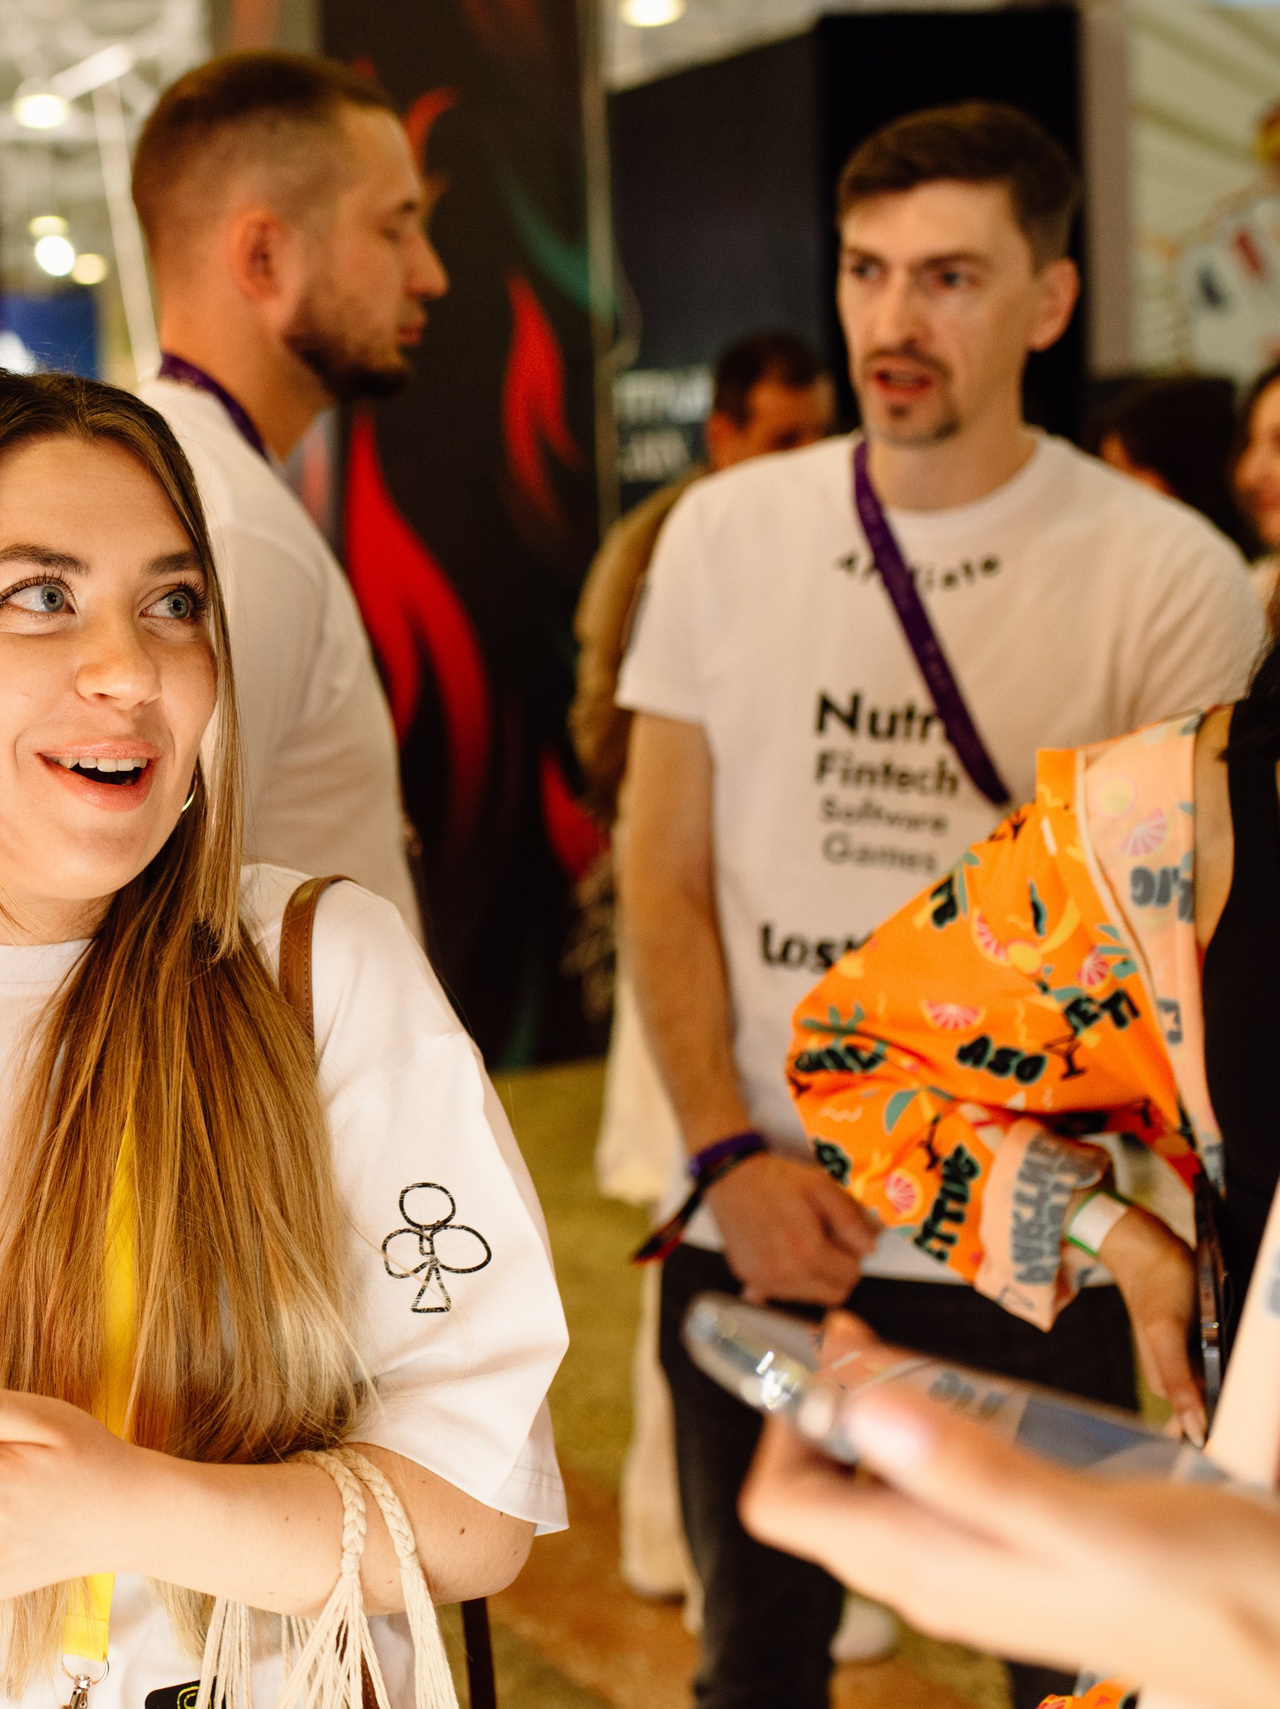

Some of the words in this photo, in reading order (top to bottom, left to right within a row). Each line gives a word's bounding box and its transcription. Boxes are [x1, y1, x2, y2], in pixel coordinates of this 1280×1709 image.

[816, 690, 942, 742] Nutr
[816, 749, 960, 797] Fintech
[822, 796, 949, 836] Software
[822, 831, 938, 876] Games
